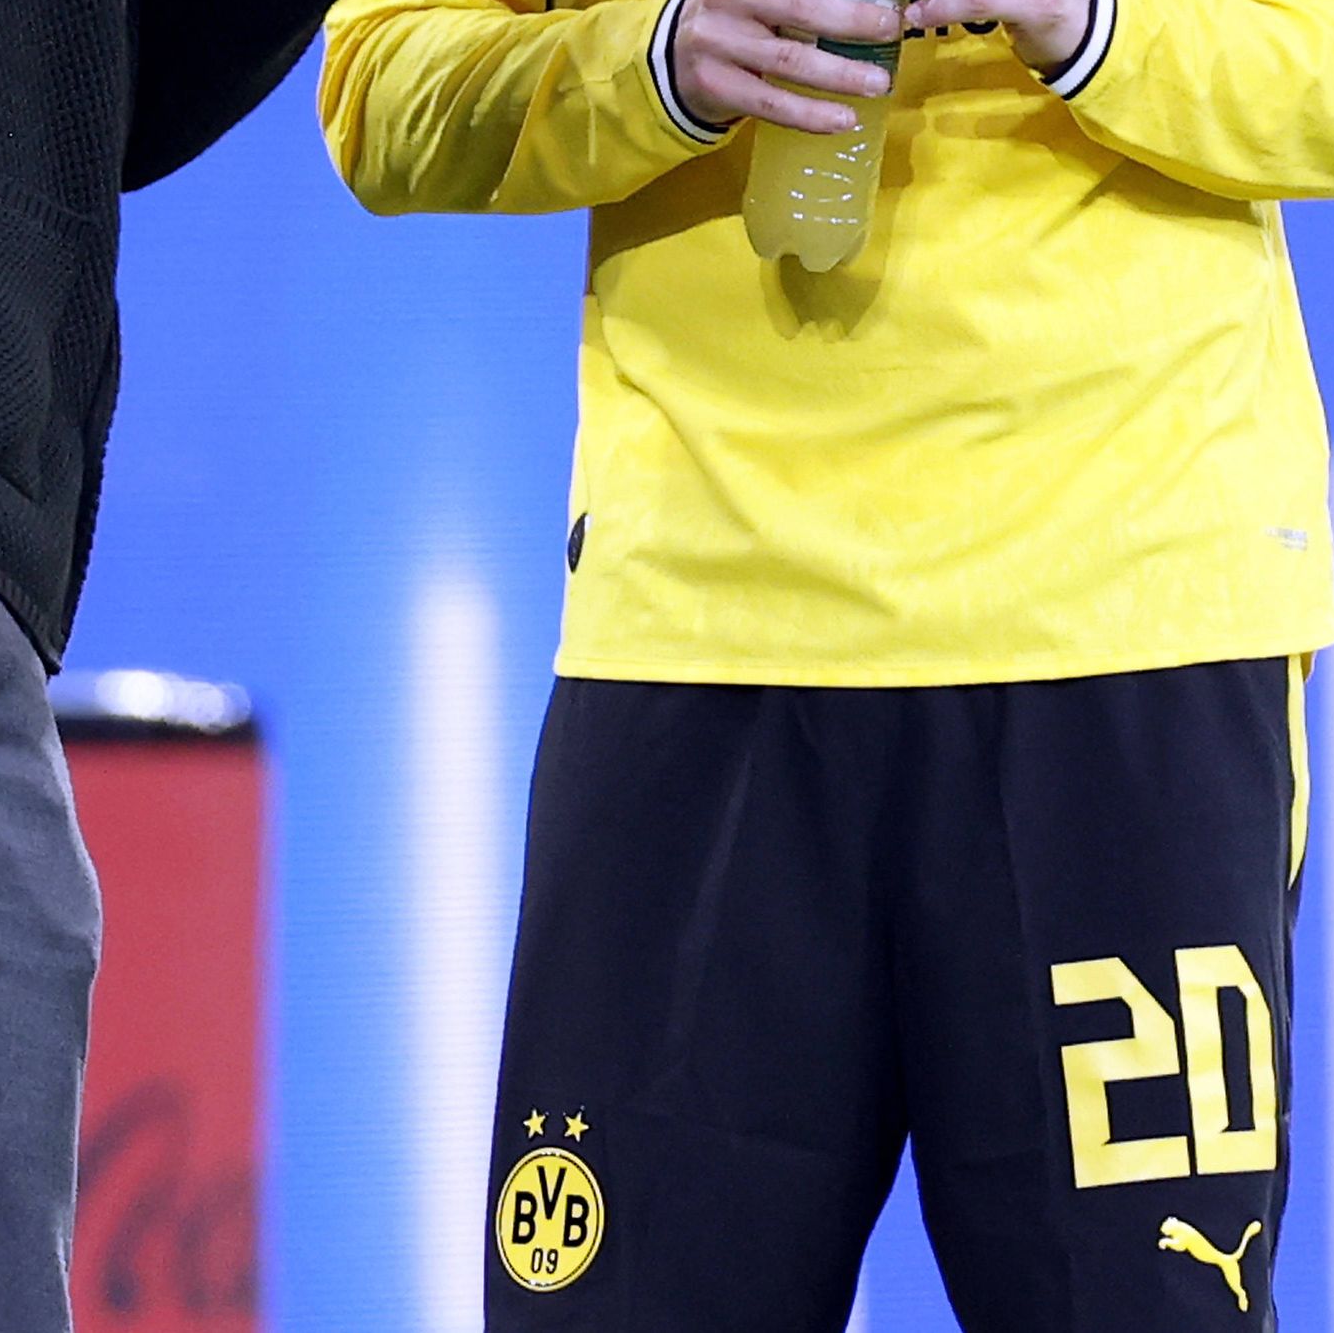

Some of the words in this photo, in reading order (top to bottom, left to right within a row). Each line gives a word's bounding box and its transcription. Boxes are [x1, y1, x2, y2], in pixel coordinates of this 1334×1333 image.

[1050, 943, 1277, 1189] 20
[511, 1164, 591, 1248] BVB
[530, 1247, 560, 1275] 09
